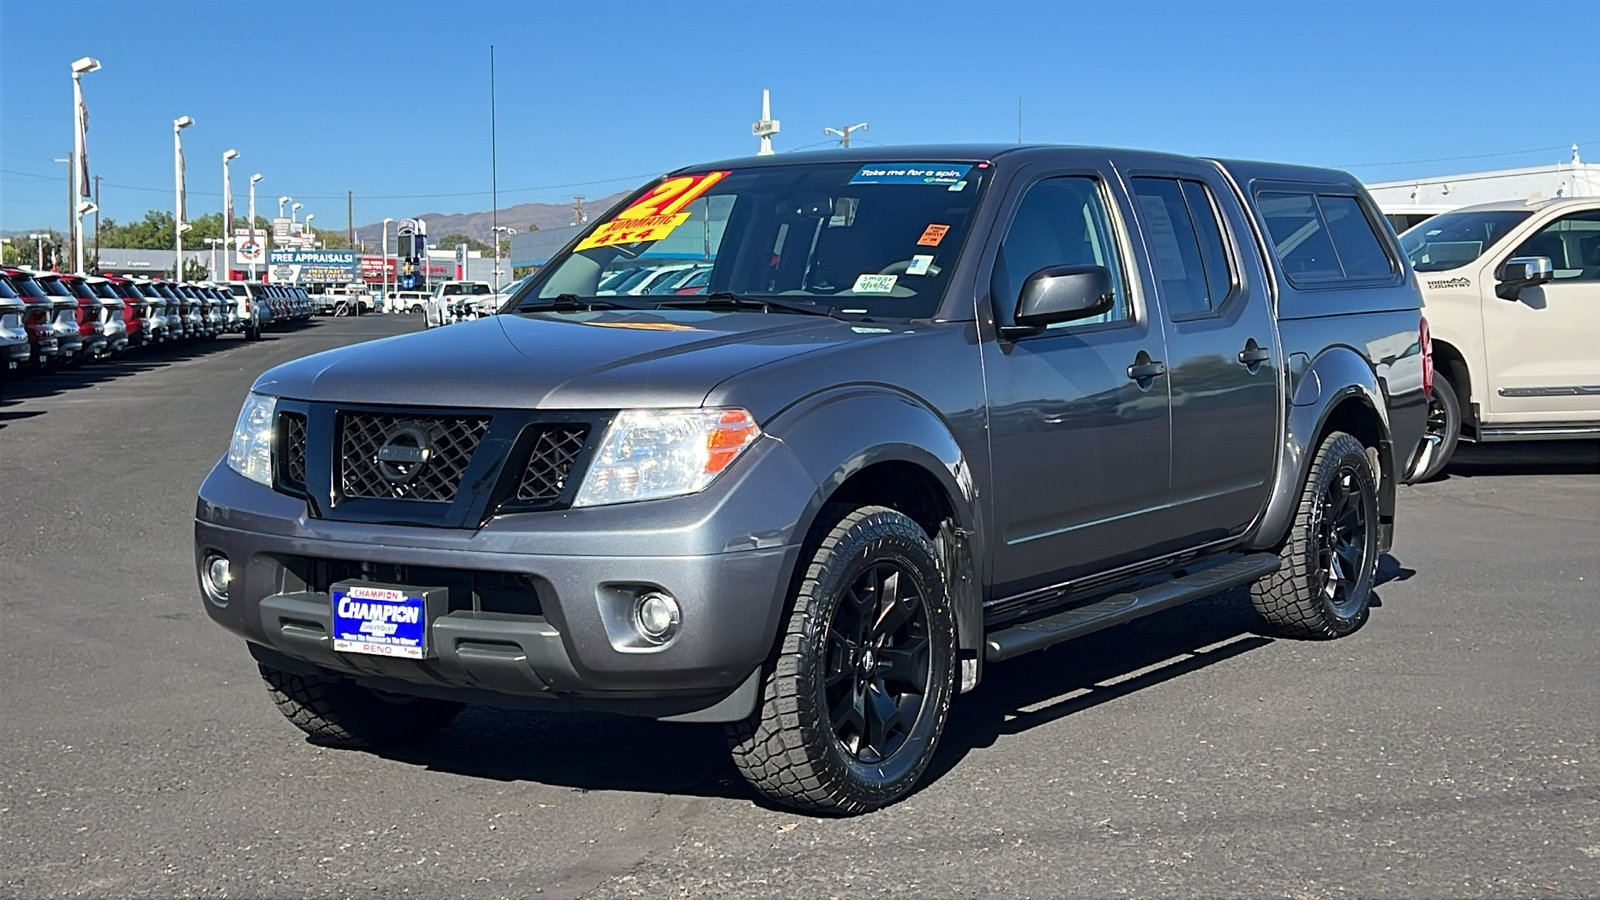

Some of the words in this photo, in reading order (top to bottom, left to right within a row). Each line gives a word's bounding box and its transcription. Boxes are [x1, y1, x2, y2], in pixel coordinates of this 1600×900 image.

[861, 169, 886, 177] Take
[935, 170, 961, 178] spin.
[617, 172, 723, 220] 21
[602, 214, 677, 234] AUTOMATIC
[271, 253, 294, 262] FREE
[295, 253, 353, 263] APPRAISALS!
[354, 589, 399, 600] CHAMPION
[338, 597, 419, 624] CHAMPION
[362, 624, 395, 632] CHEVROLET
[363, 644, 393, 654] RENO
